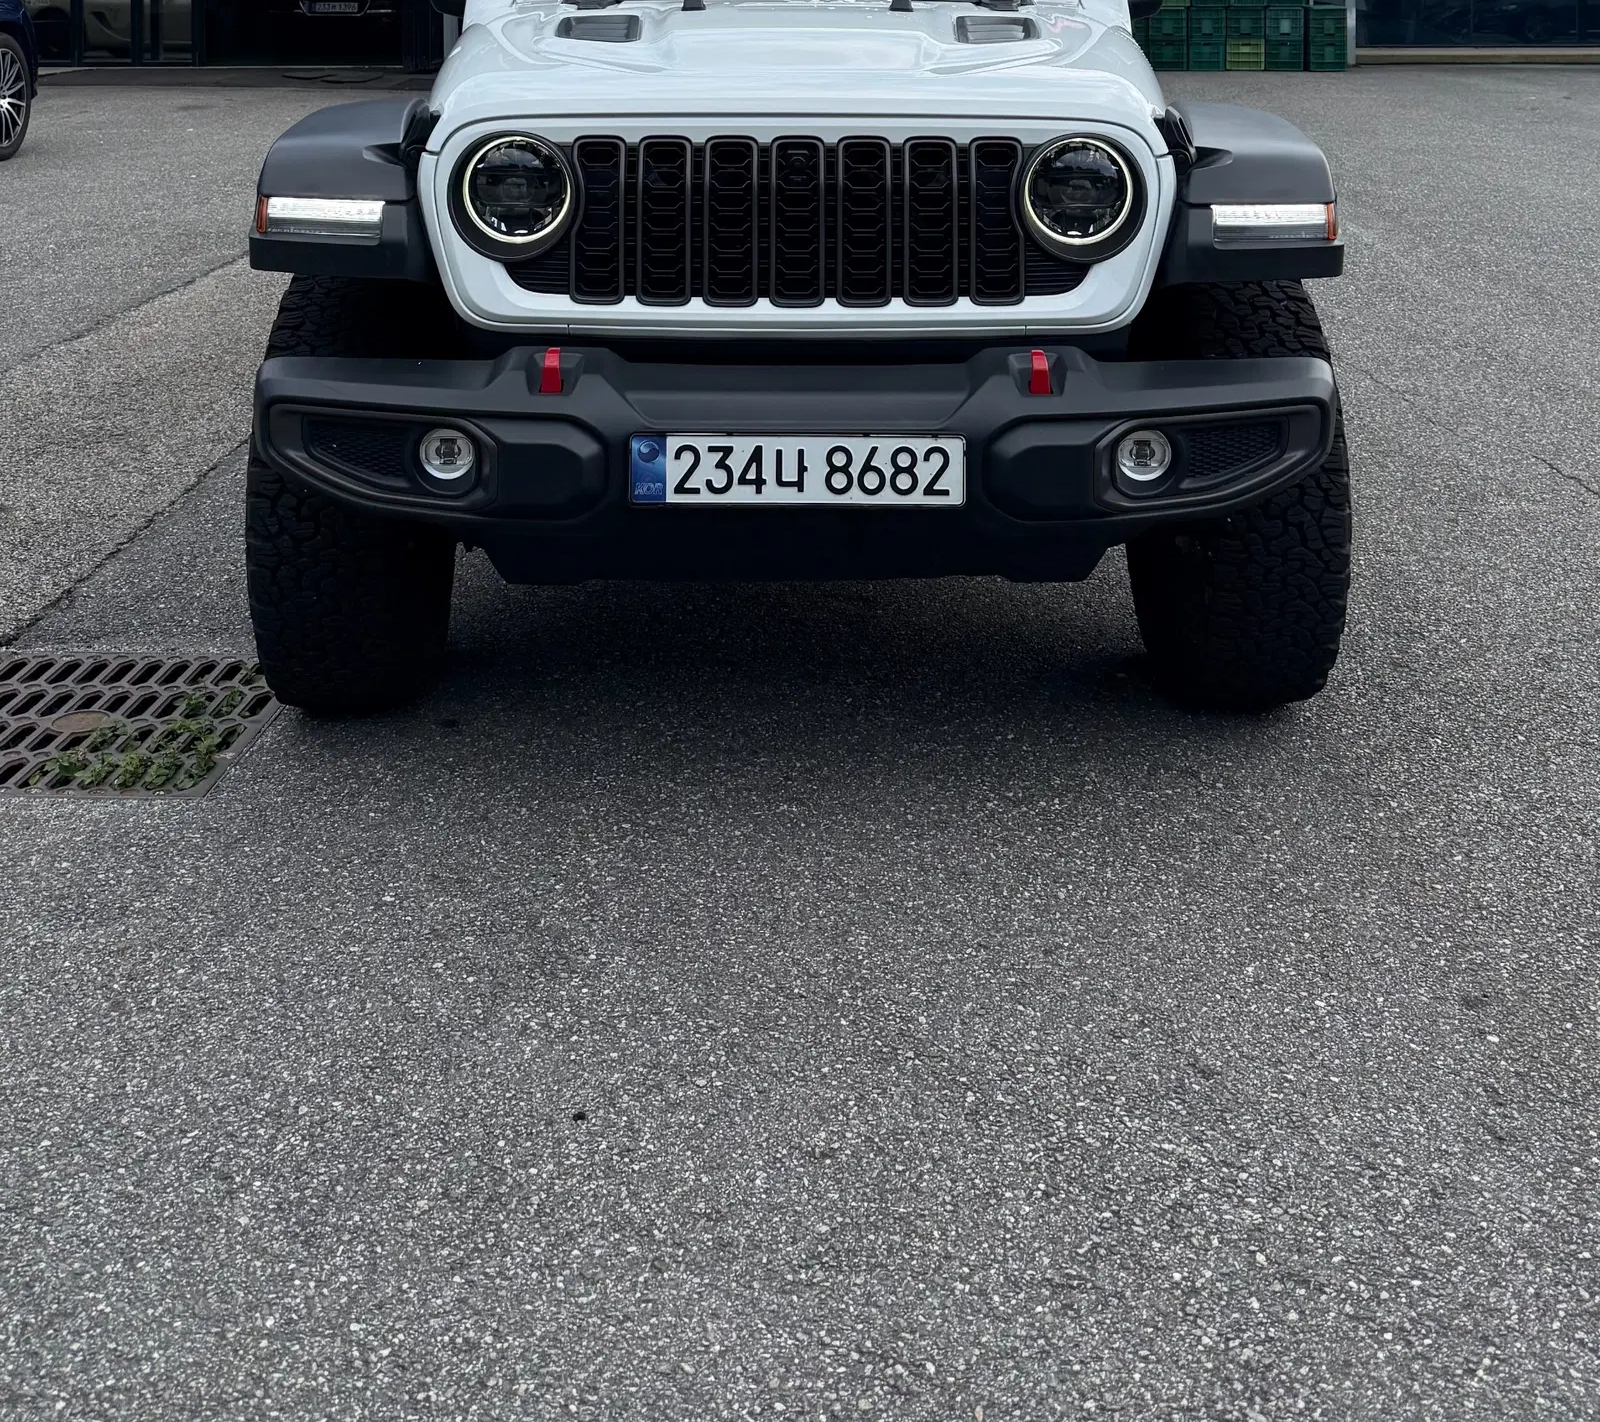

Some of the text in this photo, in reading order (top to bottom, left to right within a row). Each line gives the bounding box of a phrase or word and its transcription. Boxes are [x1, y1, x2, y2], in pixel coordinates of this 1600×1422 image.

[673, 444, 951, 496] 234나 8682
[634, 482, 664, 495] KOR
